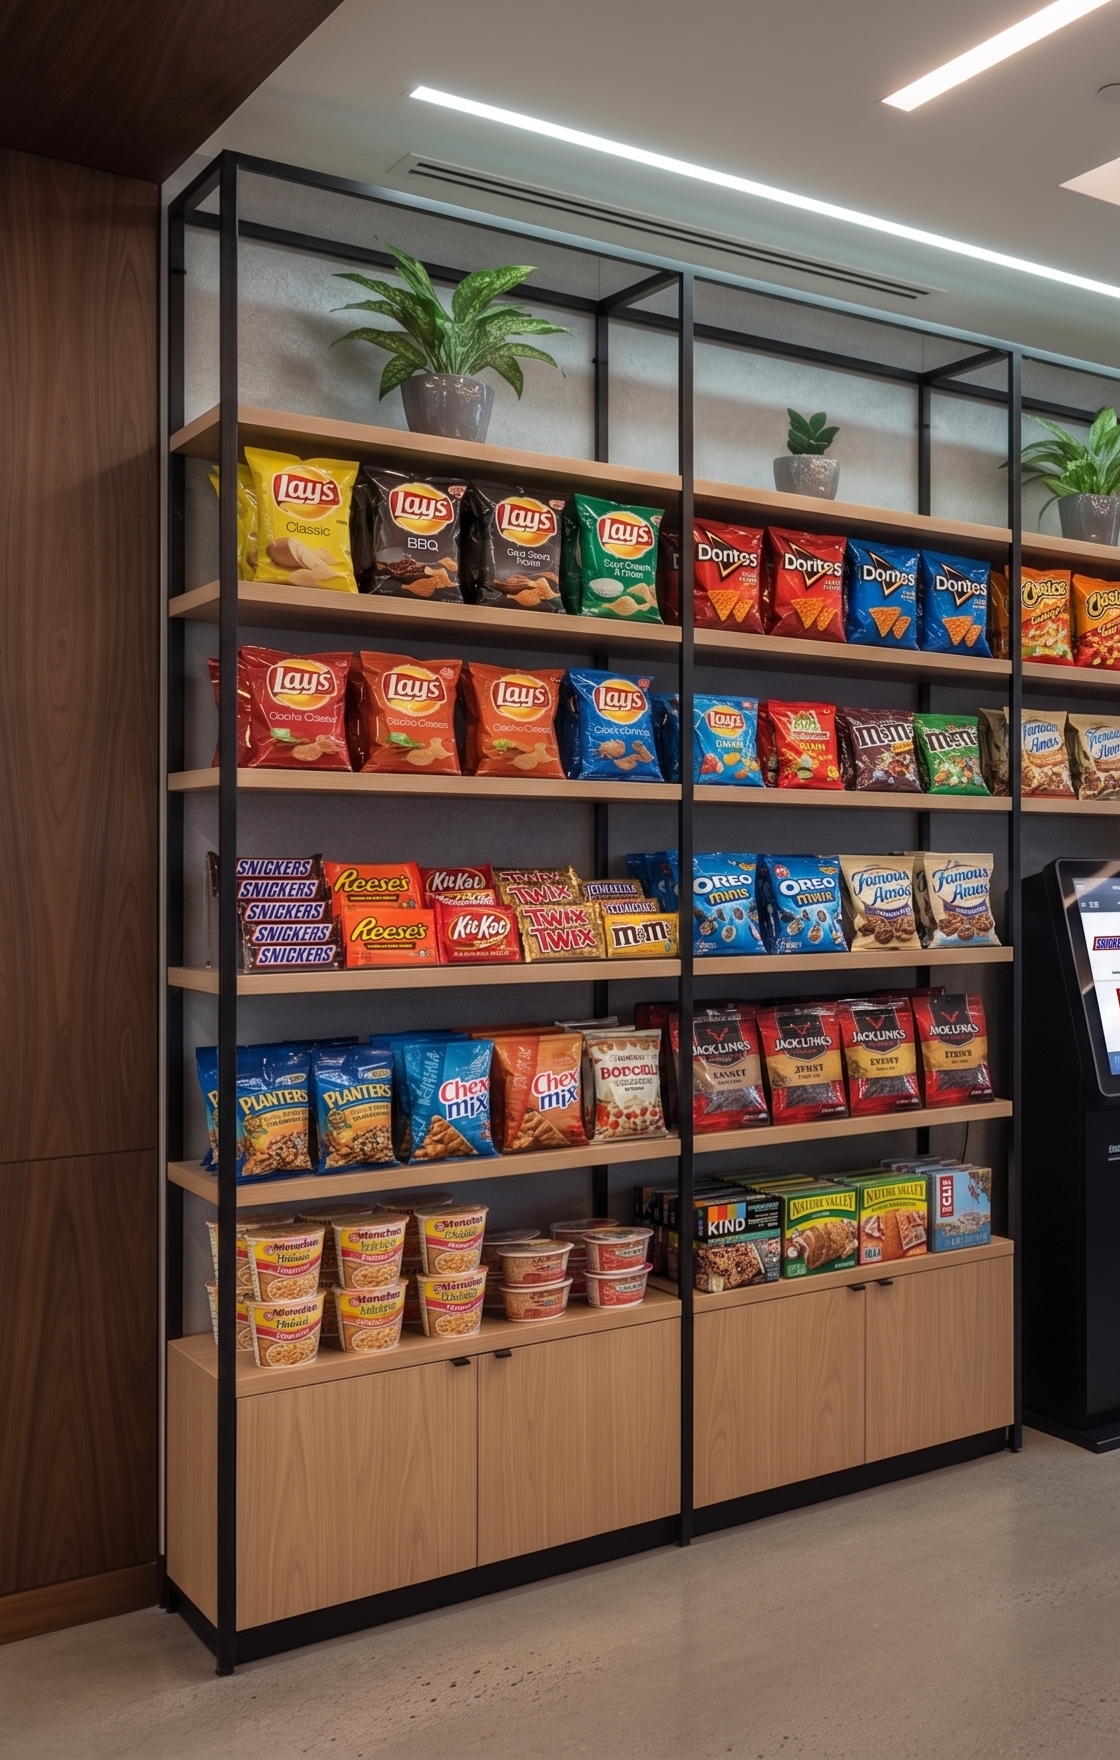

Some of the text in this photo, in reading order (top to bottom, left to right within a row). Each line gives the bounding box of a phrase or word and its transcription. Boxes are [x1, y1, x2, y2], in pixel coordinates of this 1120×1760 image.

[286, 521, 331, 537] Classic
[407, 537, 439, 552] BBQ
[237, 860, 310, 876] SNICKERS
[240, 882, 316, 898] SNICKERS
[334, 868, 410, 893] Reese's
[693, 874, 753, 895] OREO
[780, 877, 835, 896] OREO
[507, 885, 572, 904] TWIX
[247, 904, 323, 920] SNICKERS
[522, 908, 588, 929] TWIX
[255, 926, 330, 942] SNICKERS
[351, 916, 428, 942] Reese's
[529, 928, 597, 953] TWIX
[259, 947, 333, 964] SNICKERS
[440, 1079, 489, 1103] Chex
[533, 1069, 578, 1095] Chex
[239, 1089, 308, 1115] PLANTERS
[323, 1083, 392, 1109] PLANTERS
[447, 1094, 488, 1119] mix
[540, 1086, 578, 1111] mix
[708, 1218, 746, 1236] KIND
